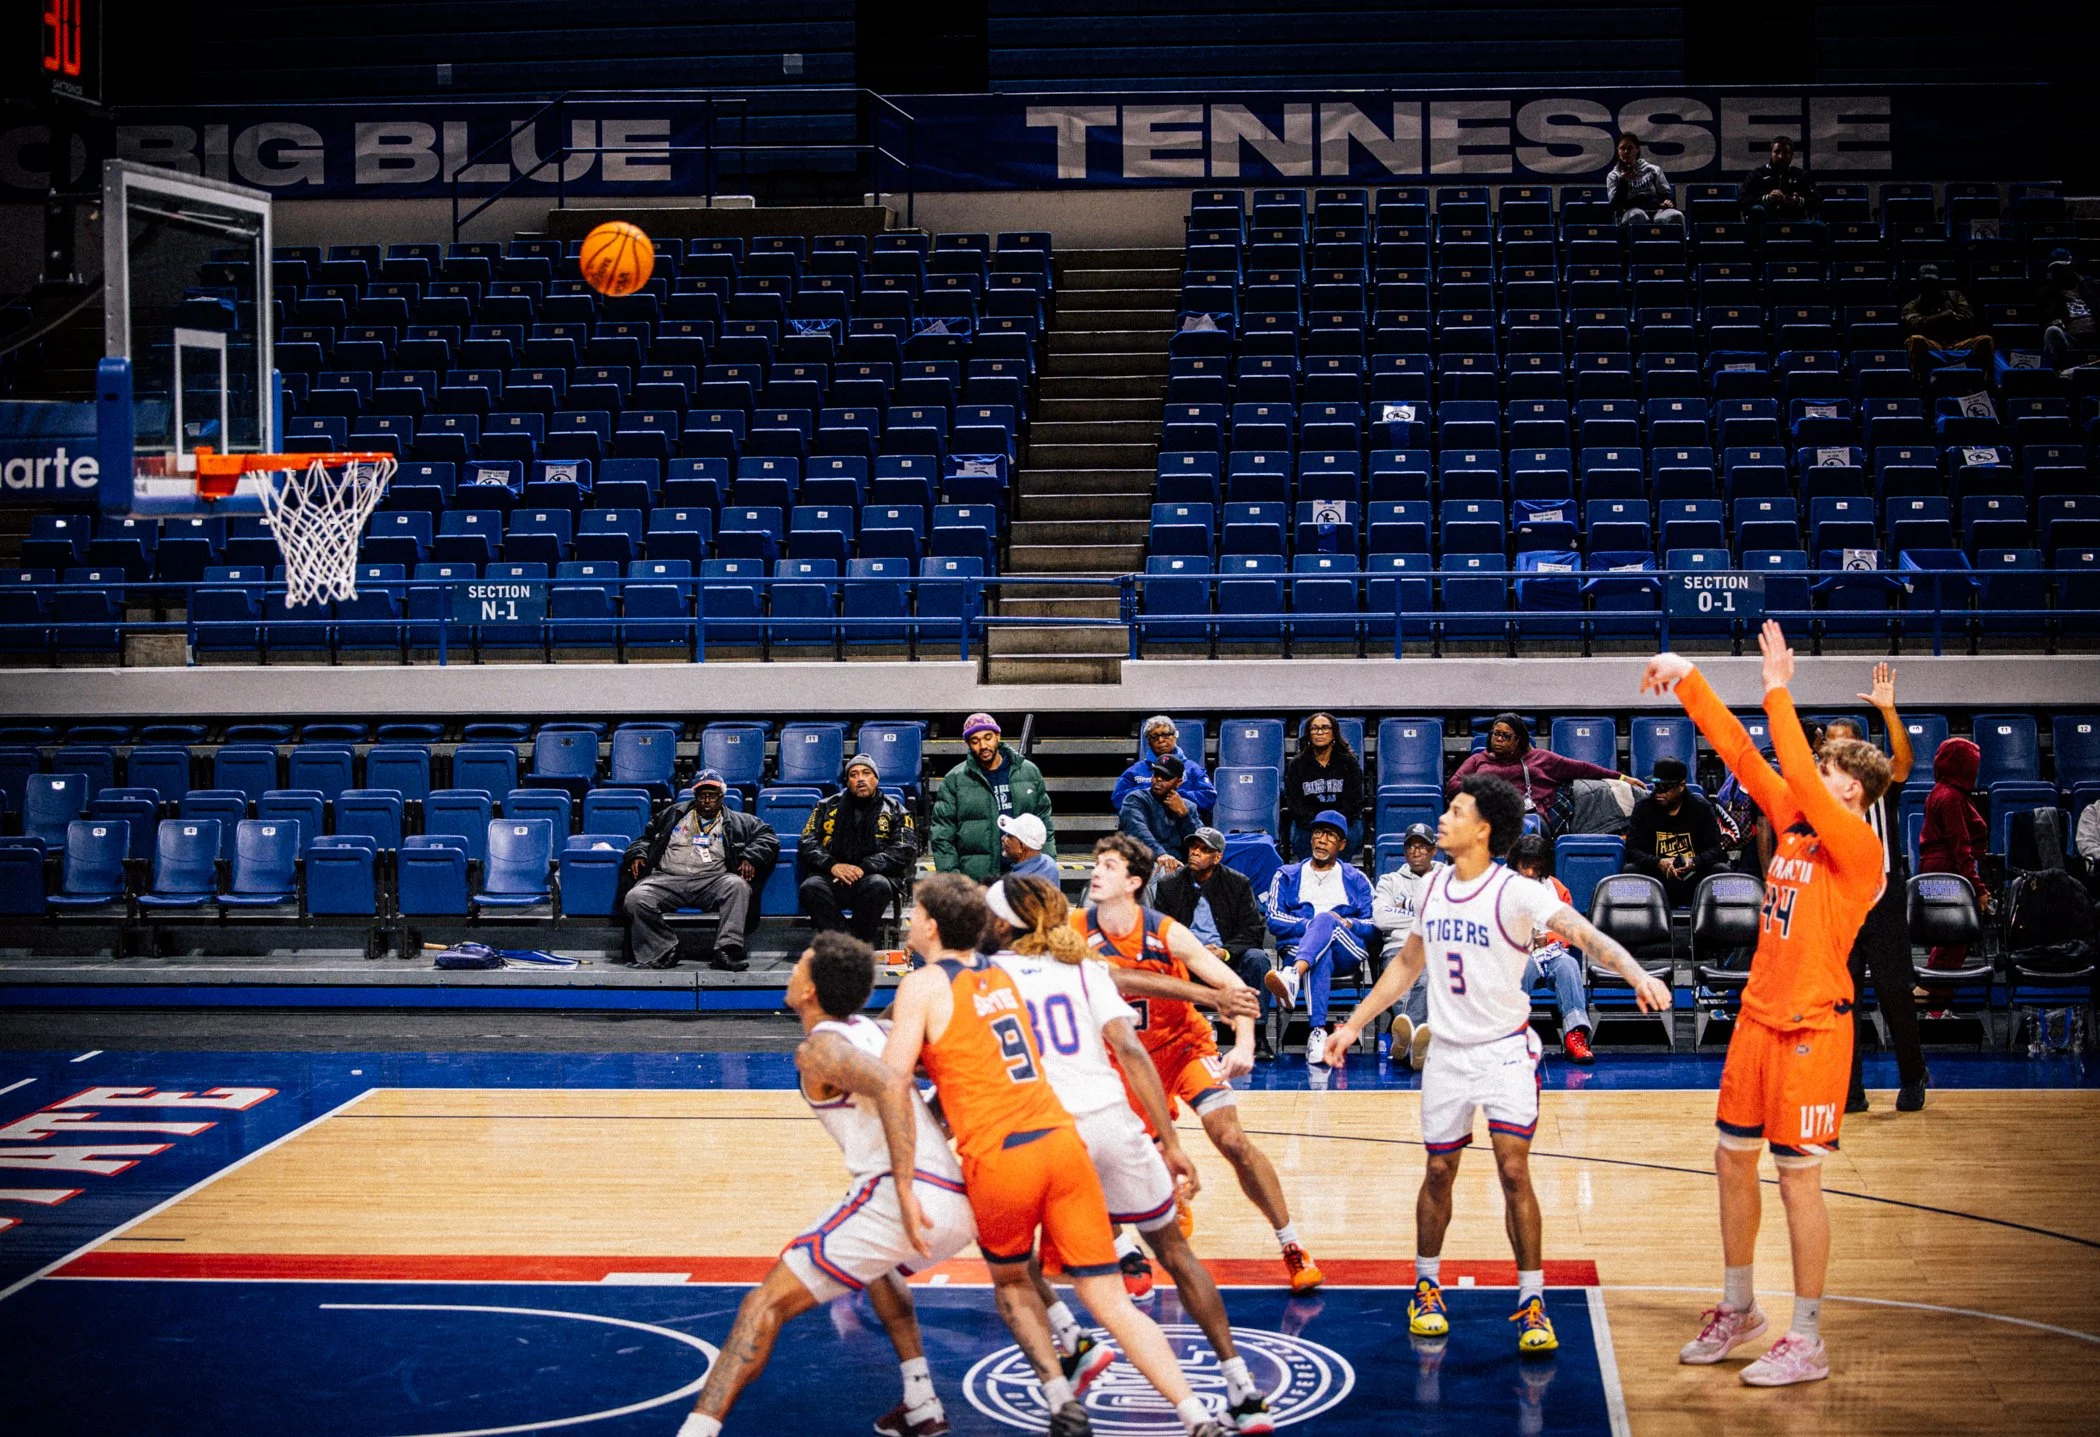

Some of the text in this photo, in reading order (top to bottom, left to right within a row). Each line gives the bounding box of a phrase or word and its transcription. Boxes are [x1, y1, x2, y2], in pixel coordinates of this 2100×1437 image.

[116, 121, 325, 187] BIG
[355, 119, 672, 184] BLUE
[1026, 96, 1893, 179] TENNESSEE
[0, 448, 99, 490] arte
[468, 585, 530, 598] SECTION
[1684, 576, 1749, 589] SECTION
[482, 601, 519, 620] N-1
[1426, 918, 1489, 948] TIGERS
[1446, 951, 1467, 996] 3
[991, 1014, 1039, 1084] 9
[0, 1086, 280, 1233] ATE
